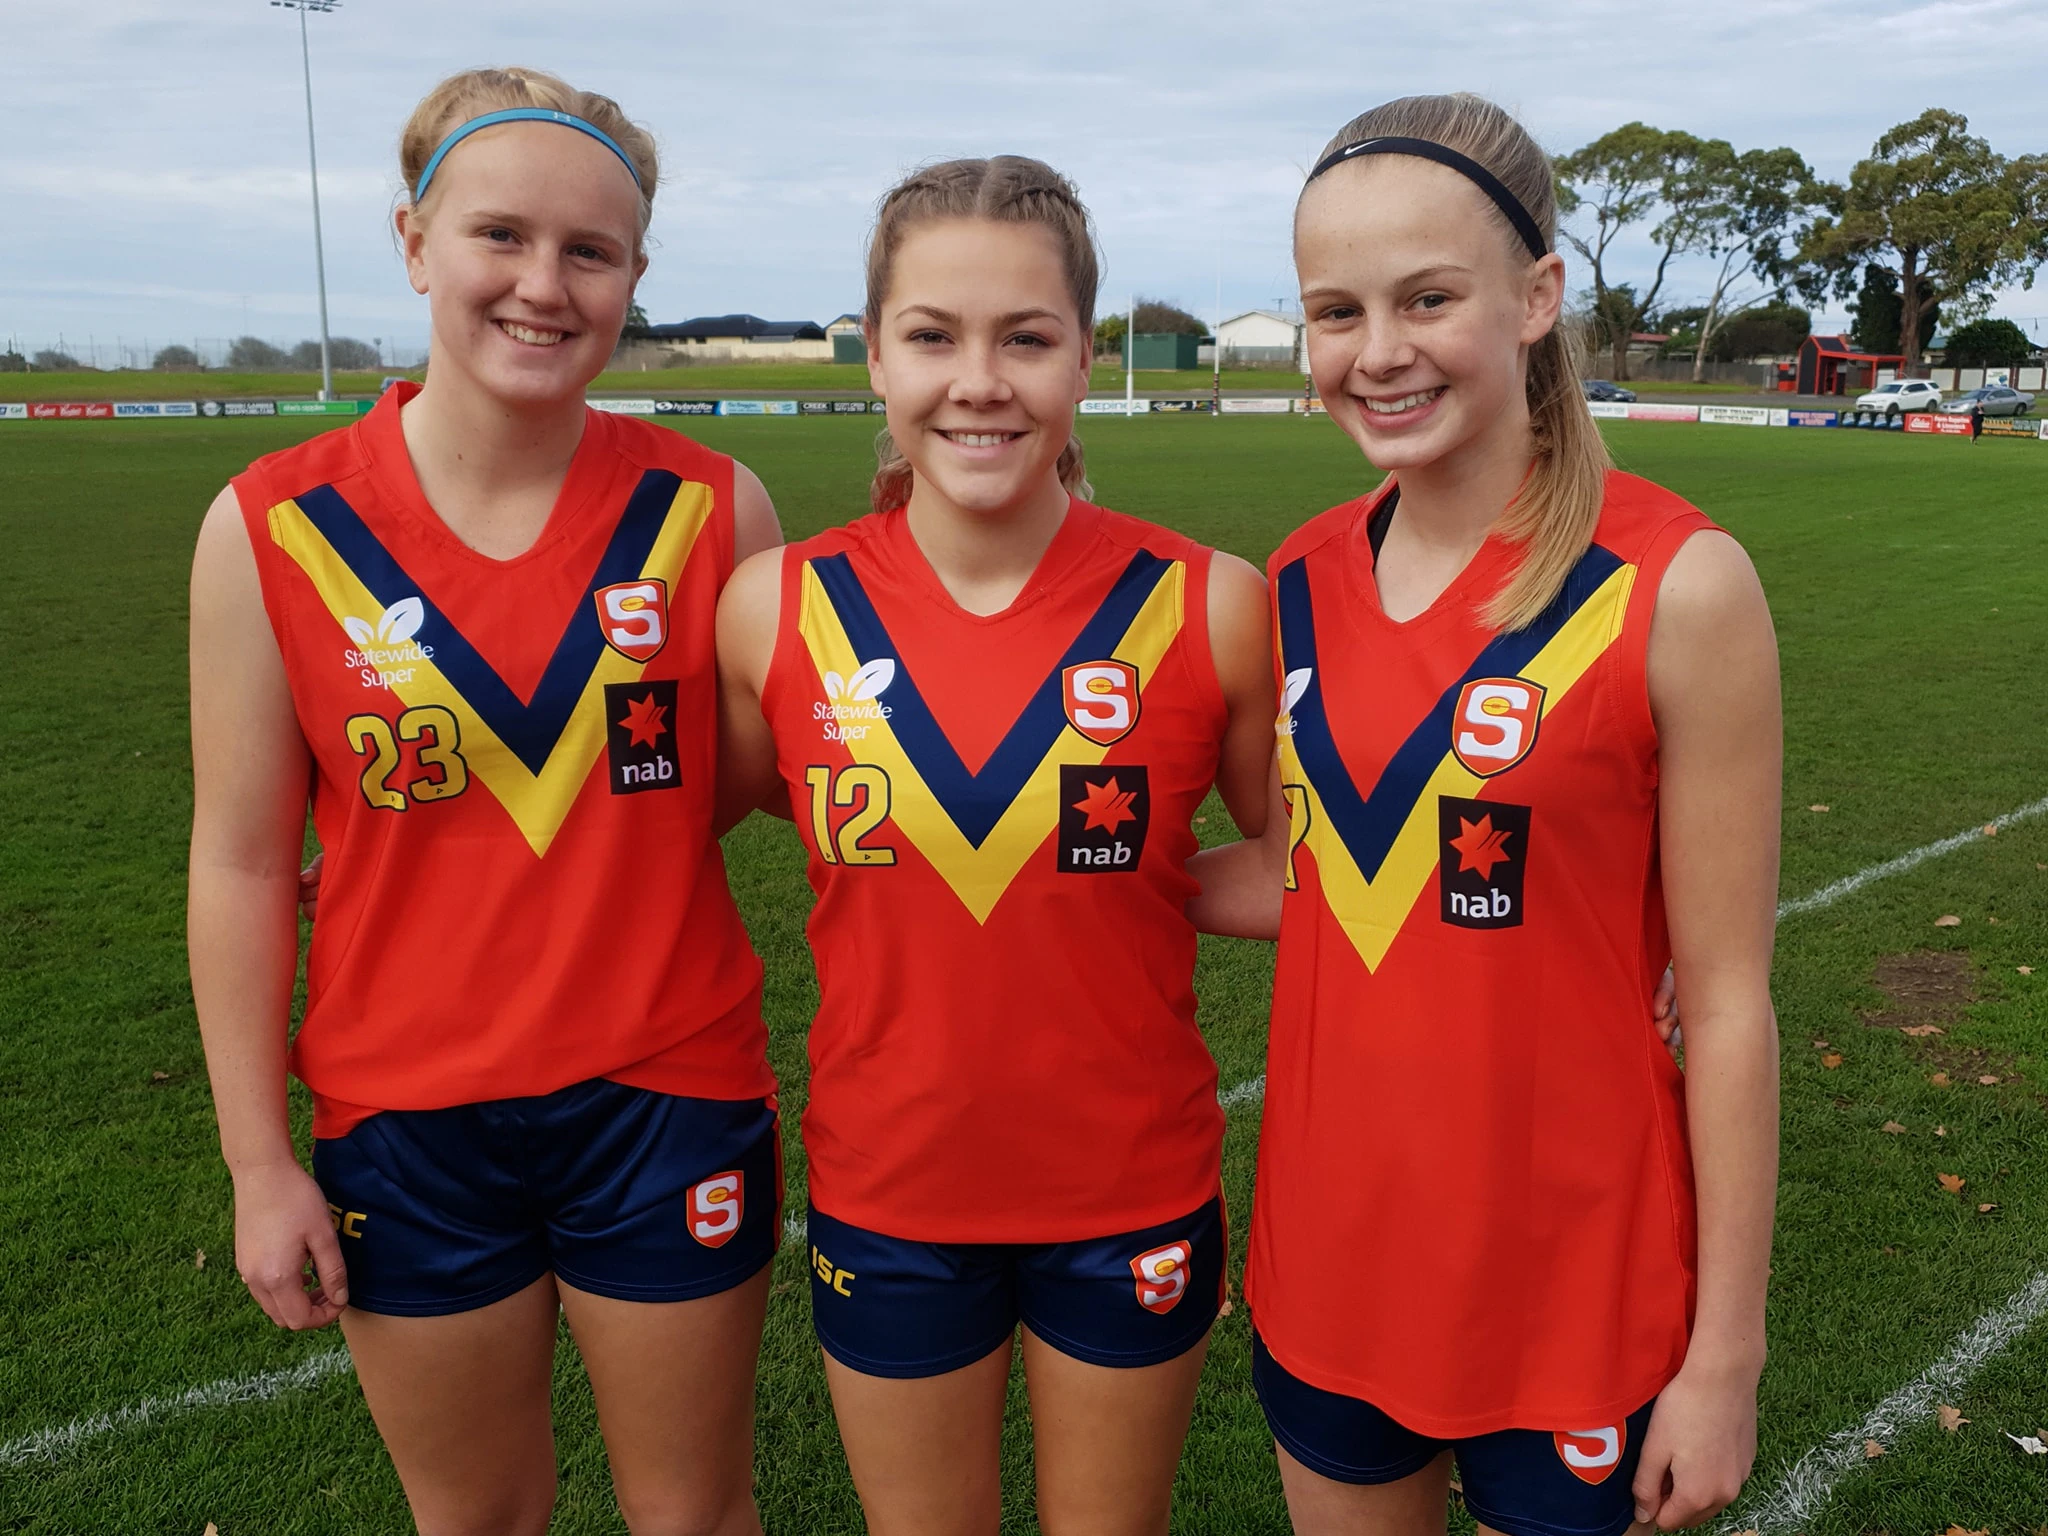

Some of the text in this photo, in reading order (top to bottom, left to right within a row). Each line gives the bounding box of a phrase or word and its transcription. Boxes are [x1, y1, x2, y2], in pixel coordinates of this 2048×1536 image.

[605, 584, 661, 647] S
[344, 641, 434, 669] Statewide
[361, 665, 416, 690] Super
[813, 701, 893, 721] Statewide
[1073, 667, 1130, 729] S
[823, 721, 871, 744] Super
[1458, 684, 1530, 760] S
[345, 704, 470, 812] 23
[622, 756, 673, 785] nab
[806, 764, 898, 866] 12
[1071, 841, 1132, 866] nab
[1450, 887, 1512, 919] nab
[327, 1202, 368, 1239] SC
[695, 1175, 739, 1239] S
[811, 1244, 856, 1298] ISC
[1139, 1246, 1187, 1306] S
